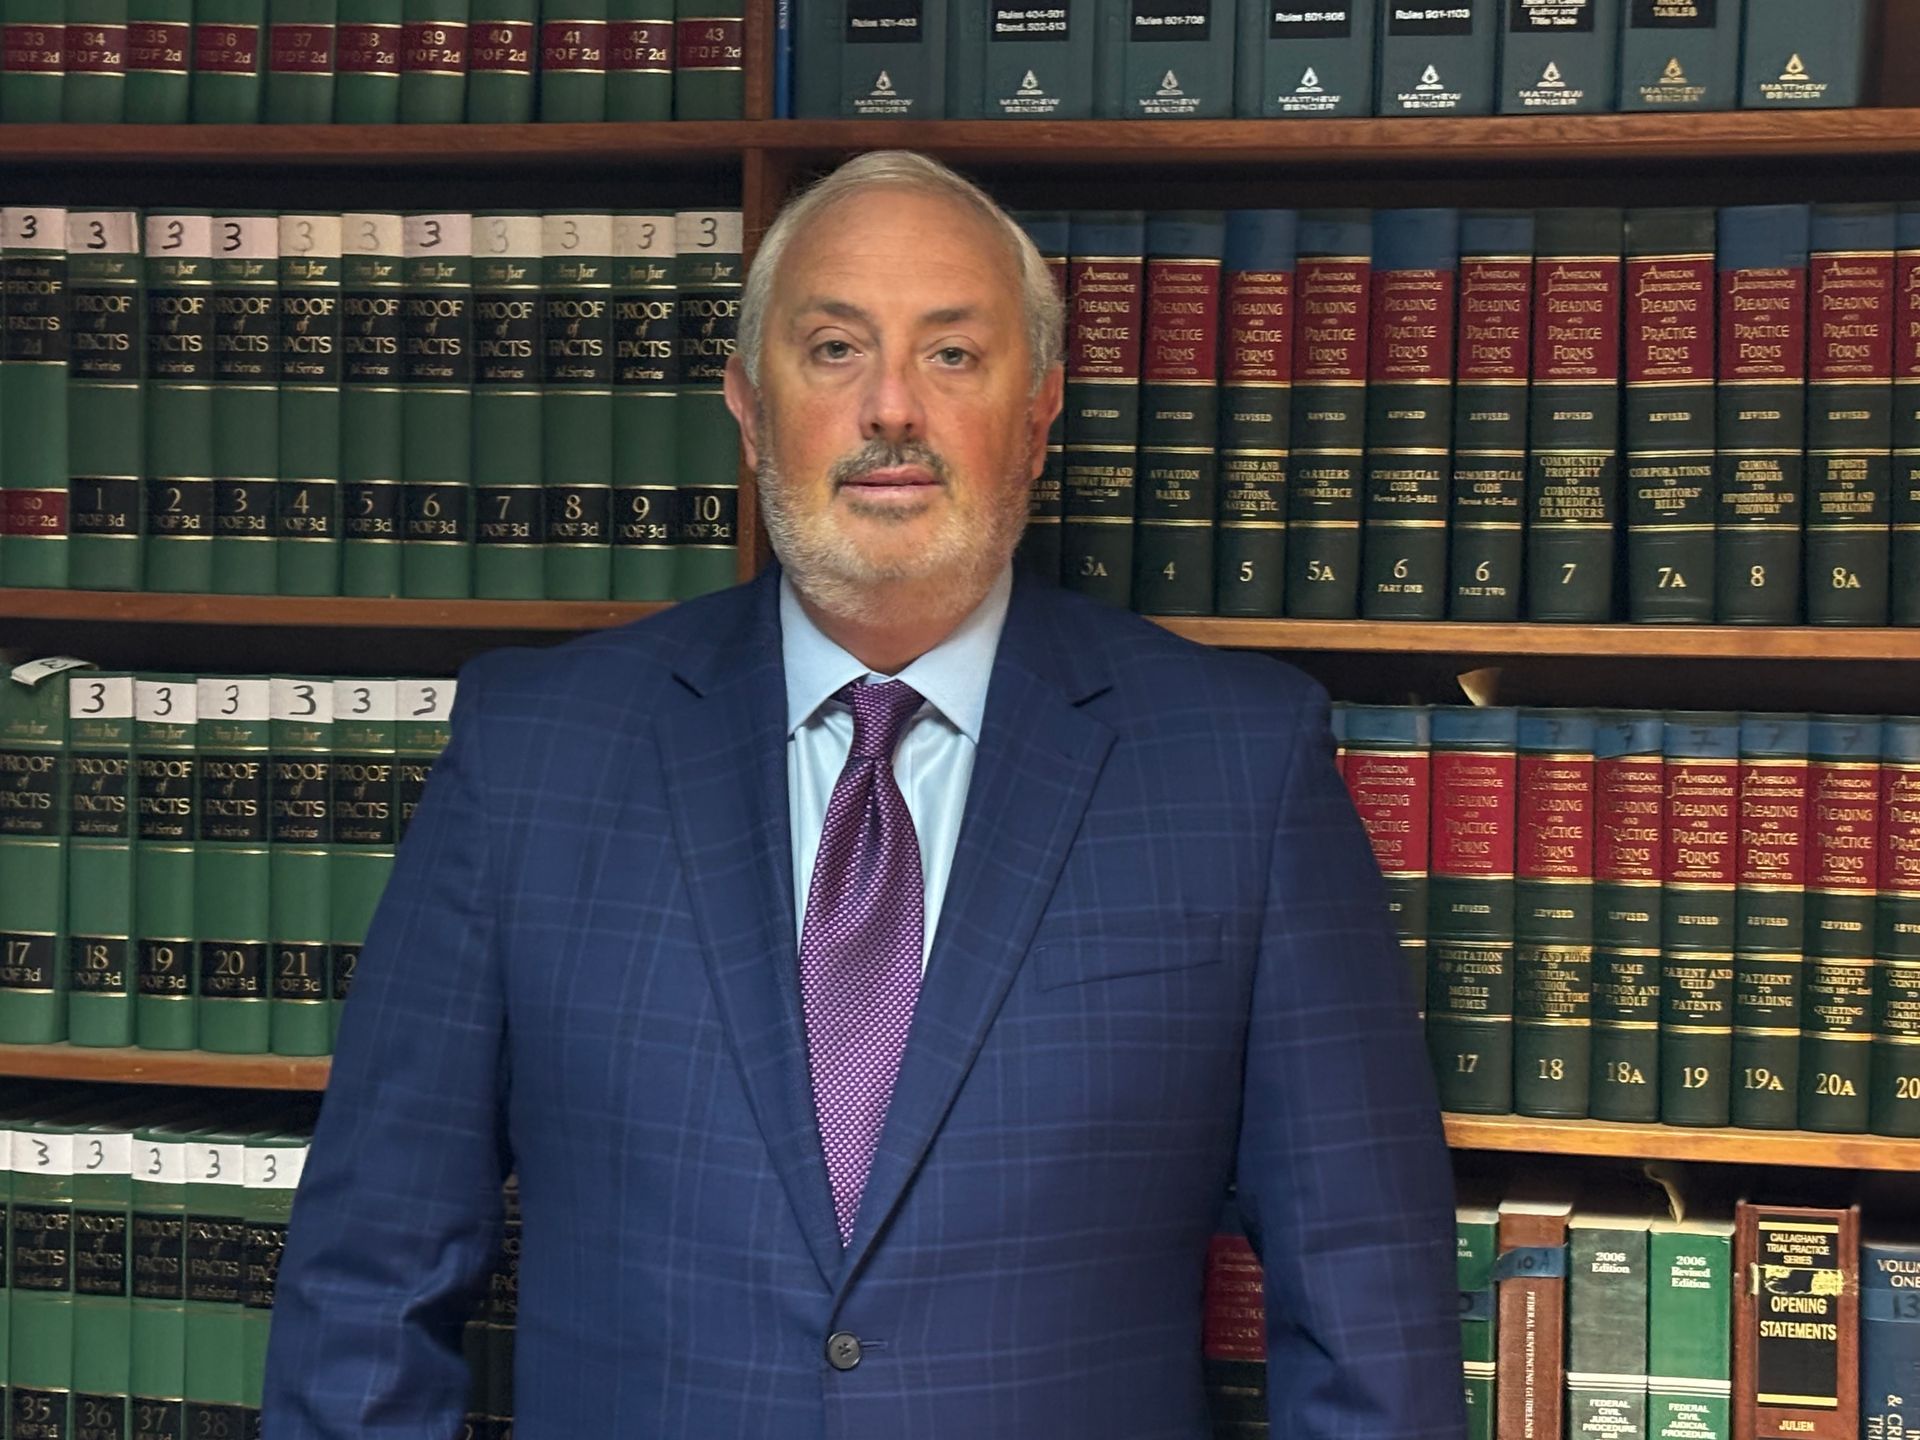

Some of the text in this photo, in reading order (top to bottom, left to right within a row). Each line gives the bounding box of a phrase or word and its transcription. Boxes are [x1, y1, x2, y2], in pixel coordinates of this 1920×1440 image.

[1276, 13, 1302, 22] Rules
[1395, 10, 1423, 19] Rules
[1529, 7, 1578, 16] Author and
[1135, 16, 1162, 25] Rules
[84, 33, 105, 46] 34
[422, 31, 446, 45] 39
[564, 30, 580, 44] 41
[629, 30, 649, 44] 42
[705, 28, 724, 42] 43
[100, 51, 120, 64] 2d
[442, 50, 461, 63] 2d
[509, 50, 527, 63] 2d
[853, 99, 914, 107] MATTHEW
[20, 215, 38, 239] 3
[87, 221, 107, 249] 3
[162, 220, 184, 250] 3
[419, 220, 441, 247] 3
[560, 220, 580, 249] 3
[696, 217, 717, 248] 3
[223, 223, 242, 251] 3
[292, 221, 313, 251] 3
[360, 221, 380, 251] 3
[491, 219, 510, 253] 3
[637, 223, 656, 250] 3
[551, 301, 605, 318] PROOF
[615, 302, 675, 319] PROOF
[682, 300, 740, 317] PROOF
[1078, 301, 1130, 313] PLEADING
[1467, 299, 1520, 312] PLEADING
[1078, 327, 1129, 340] PRACTICE
[1467, 325, 1520, 340] PRACTICE
[618, 341, 671, 358] FACTS
[1082, 347, 1121, 360] FORMS
[1472, 346, 1511, 360] FORMS
[1540, 457, 1606, 467] COMMUNITY
[1545, 468, 1600, 477] PROPERTY
[1629, 466, 1711, 478] CORPORATIONS
[1473, 483, 1502, 493] CODE
[1544, 486, 1600, 496] CORONERS
[96, 488, 103, 510] 1
[167, 488, 182, 512] 2
[234, 488, 248, 512] 3
[293, 489, 310, 514] 4
[361, 490, 375, 514] 5
[423, 493, 441, 517] 6
[496, 495, 511, 519] 7
[565, 494, 582, 519] 8
[1556, 498, 1605, 508] MEDICAL
[1655, 500, 1686, 509] BILLS
[632, 496, 650, 521] 9
[693, 496, 721, 520] 10
[1540, 508, 1604, 518] EXAMINERS
[181, 515, 200, 529] 3d
[308, 517, 327, 532] 3d
[648, 525, 667, 539] 3d
[1080, 556, 1108, 576] 3A
[1163, 561, 1175, 580] 4
[1239, 561, 1253, 582] 5
[1307, 560, 1335, 581] 5A
[1393, 558, 1409, 578] 6
[1475, 560, 1491, 582] 6
[1562, 563, 1577, 584] 7
[1658, 567, 1687, 588] 7A
[1751, 566, 1765, 587] 8
[1833, 567, 1861, 588] 8A
[81, 683, 105, 713] 3
[153, 687, 172, 716] 3
[221, 684, 239, 715] 3
[289, 685, 317, 715] 3
[352, 688, 371, 713] 3
[412, 687, 437, 716] 3
[1672, 801, 1728, 817] PLEADING
[1742, 802, 1799, 818] PLEADING
[1672, 829, 1728, 845] PRACTICE
[1742, 830, 1799, 846] PRACTICE
[1678, 849, 1720, 865] FORMS
[1747, 850, 1790, 866] FORMS
[1677, 915, 1719, 925] REVISED
[8, 942, 30, 965] 17
[86, 945, 109, 970] 18
[152, 947, 173, 971] 19
[215, 950, 244, 975] 20
[282, 951, 308, 977] 21
[1611, 964, 1644, 974] NAME
[1664, 968, 1733, 979] PARENT AND
[1739, 973, 1792, 985] PAYMENT
[1680, 980, 1715, 989] CHILD
[1672, 1000, 1723, 1011] PATENTS
[1457, 1054, 1479, 1073] 17
[1538, 1059, 1564, 1080] 18
[1608, 1062, 1646, 1084] 18A
[1683, 1067, 1709, 1088] 19
[1744, 1068, 1784, 1091] 19A
[1816, 1073, 1856, 1096] 20A
[32, 1139, 50, 1166] 3
[86, 1140, 103, 1169] 3
[148, 1147, 162, 1175] 3
[205, 1150, 220, 1179] 3
[263, 1154, 277, 1182] 3
[1770, 1233, 1827, 1245] CALLAGHAN'S
[1596, 1252, 1626, 1262] 2006
[1766, 1244, 1830, 1255] TRIAL PRACTICE
[1592, 1263, 1630, 1274] Edition
[1676, 1256, 1706, 1266] 2006
[1784, 1255, 1813, 1265] SERIES
[1671, 1267, 1711, 1278] Revised
[1671, 1278, 1711, 1288] Edition
[1771, 1297, 1828, 1315] OPENING
[1760, 1321, 1837, 1341] STATEMENTS
[23, 1396, 50, 1422] 35
[1590, 1399, 1631, 1409] FEDERAL
[1668, 1403, 1711, 1413] FEDERAL
[1887, 1394, 1903, 1407] &
[85, 1402, 112, 1427] 36
[141, 1406, 167, 1430] 37
[1590, 1416, 1629, 1424] JUDICIAL
[1598, 1408, 1621, 1416] CIVIL
[1678, 1412, 1701, 1421] CIVIL
[1583, 1423, 1637, 1433] PROCEDURE
[1661, 1429, 1717, 1439] PROCEDURE
[1669, 1421, 1710, 1430] JUDICIAL
[1779, 1420, 1815, 1432] JULIEN
